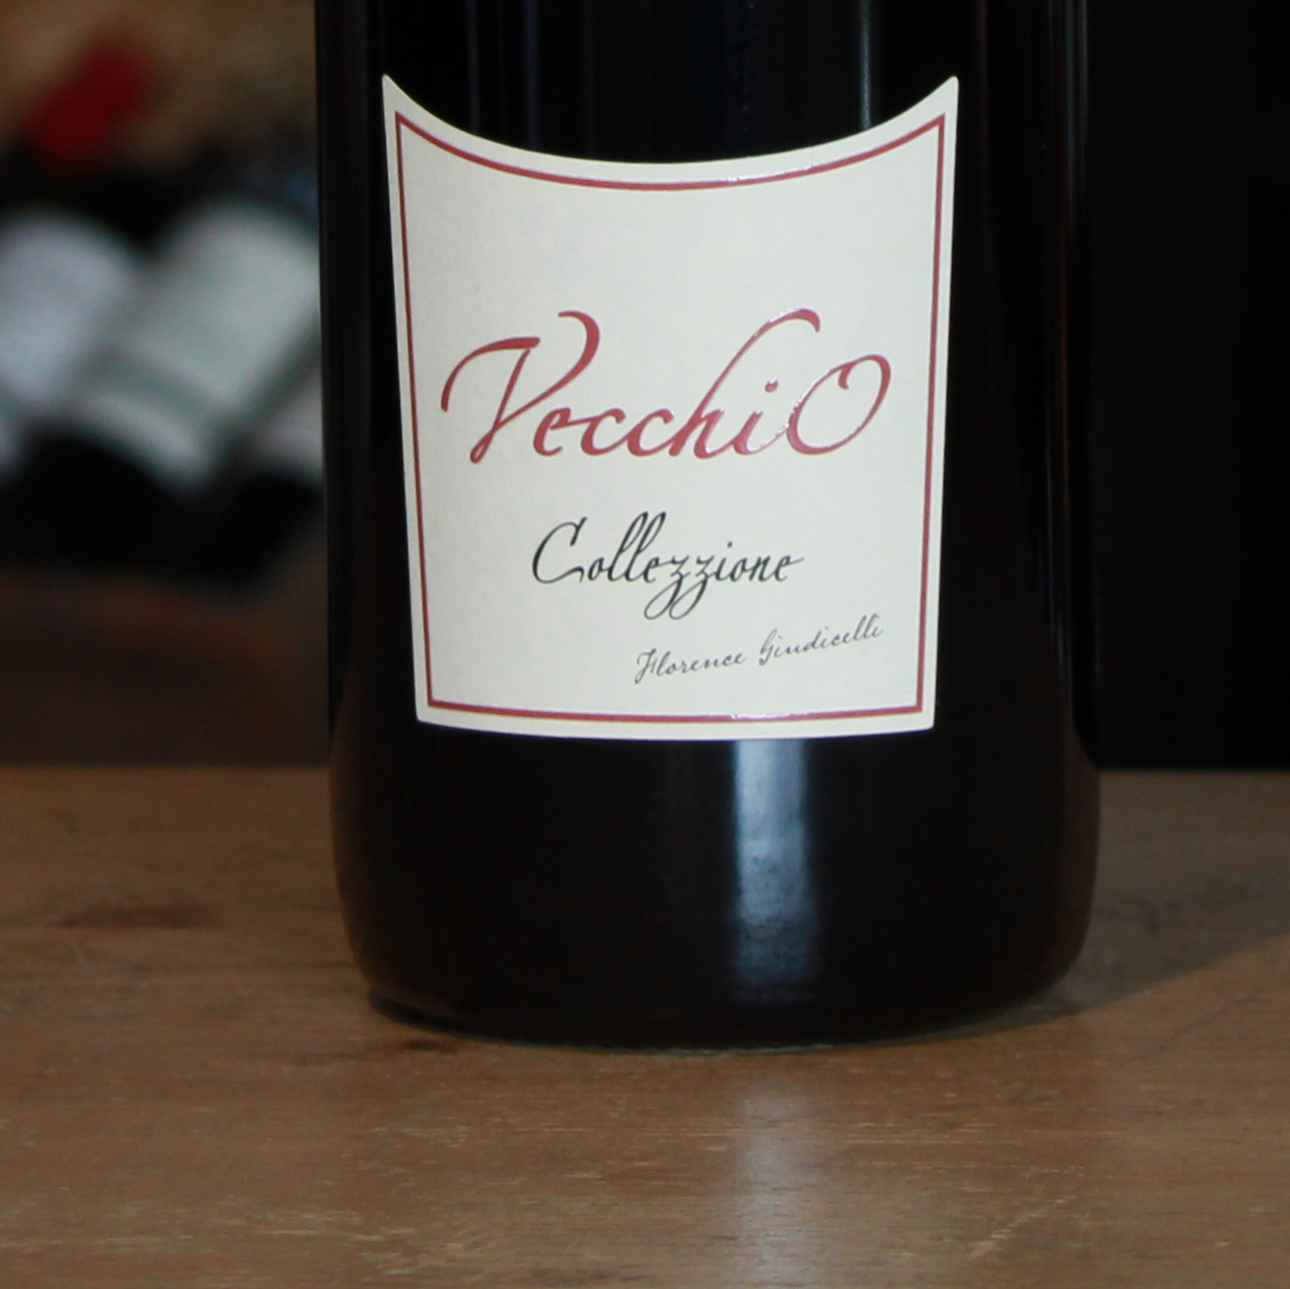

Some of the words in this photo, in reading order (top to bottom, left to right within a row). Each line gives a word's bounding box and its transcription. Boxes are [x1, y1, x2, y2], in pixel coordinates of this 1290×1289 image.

[531, 511, 805, 621] Collezzione
[634, 647, 748, 685] Florence
[758, 612, 884, 667] Giudicelli
